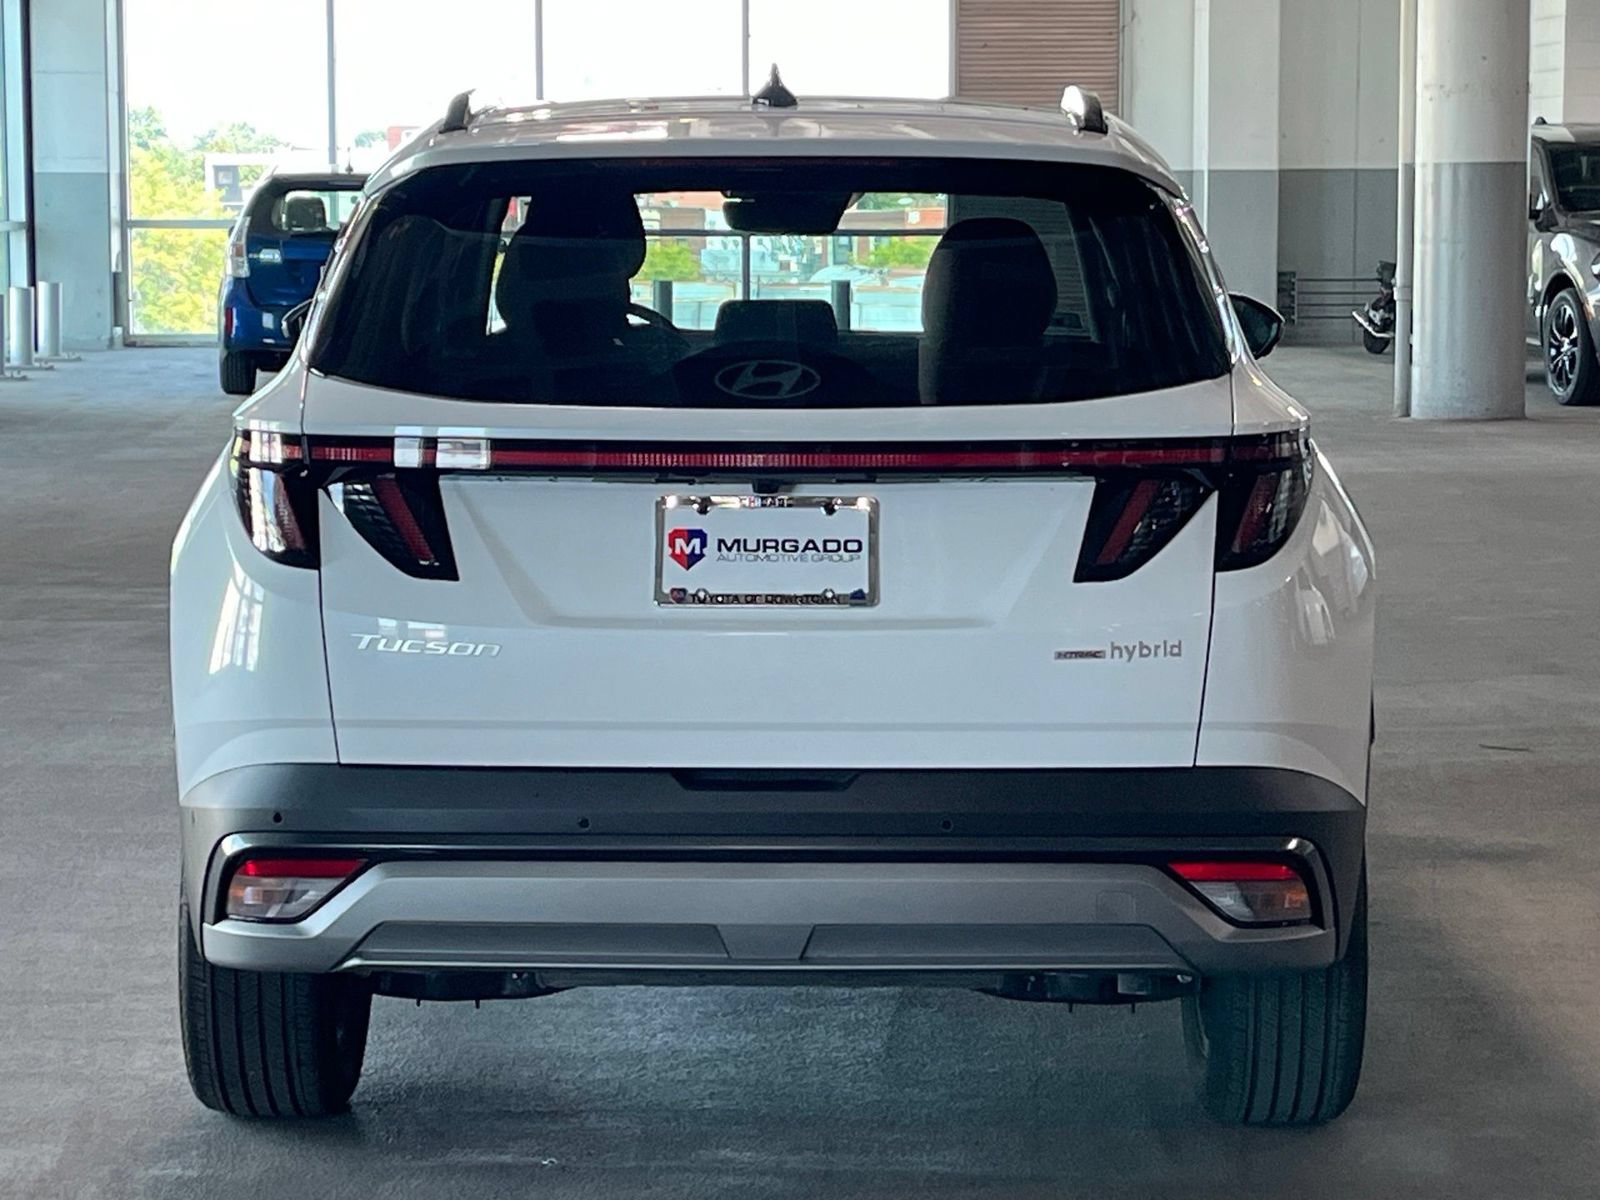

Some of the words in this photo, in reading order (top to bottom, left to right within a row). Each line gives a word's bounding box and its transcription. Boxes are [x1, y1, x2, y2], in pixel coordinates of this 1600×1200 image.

[716, 537, 863, 554] MURGADO
[716, 553, 809, 563] AUTOMOTIVE
[811, 553, 861, 563] GROUP
[1110, 640, 1182, 663] hybrid
